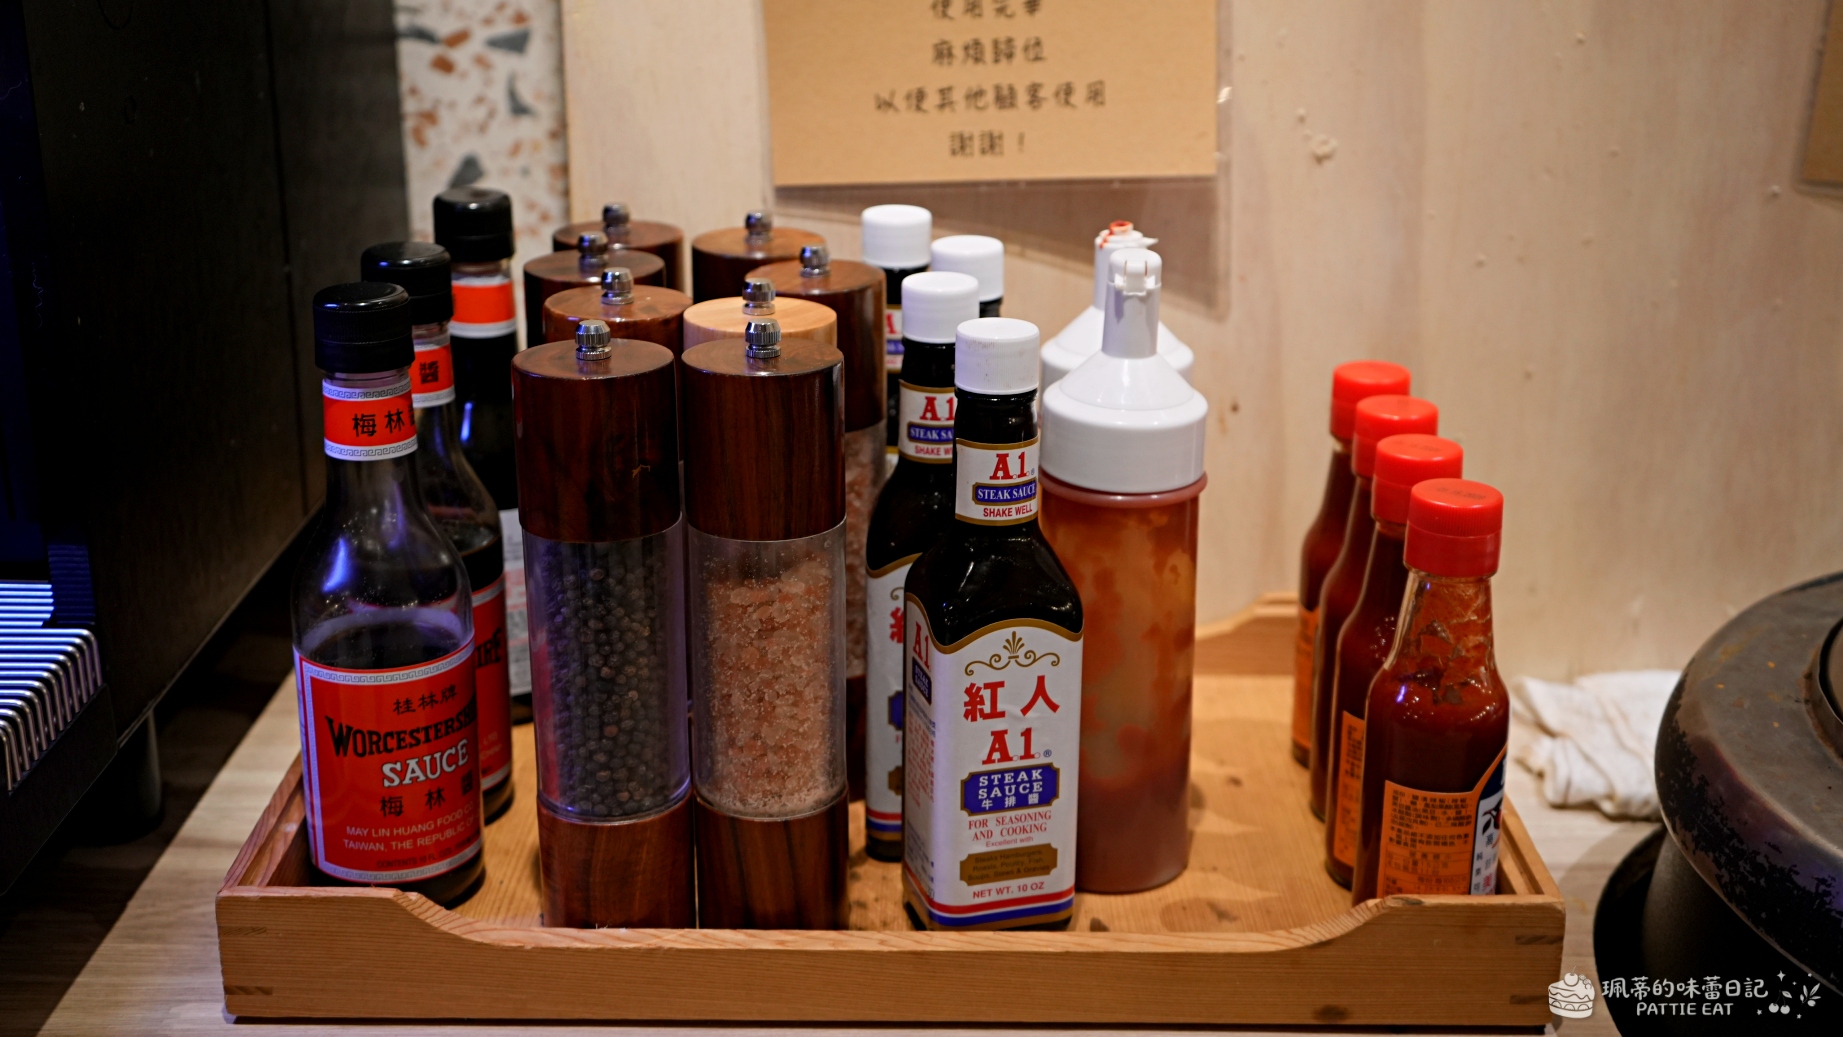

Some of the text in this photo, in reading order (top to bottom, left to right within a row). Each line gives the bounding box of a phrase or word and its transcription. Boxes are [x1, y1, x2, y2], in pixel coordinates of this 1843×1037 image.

[932, 36, 1046, 66] 麻煩歸位
[874, 80, 1108, 114] 以便其他顧客使用
[910, 426, 940, 440] STEAK
[915, 444, 942, 456] SHAKE
[977, 482, 1036, 500] STEAK SAUCE
[983, 502, 1033, 518] SHAKE WELL
[392, 684, 458, 716] 桂林牌
[963, 674, 1060, 722] 紅人
[325, 690, 477, 758] WORCESTERSH
[381, 737, 470, 789] SAUCE
[979, 768, 1043, 787] STEAK
[978, 781, 1043, 800] SAUCE
[346, 825, 370, 837] MAY
[371, 827, 391, 838] LIN
[393, 820, 435, 837] HUANG
[437, 808, 464, 827] FOOD
[968, 810, 1052, 830] FOR SEASONING
[390, 839, 414, 850] THE
[417, 820, 466, 847] REPUBLIC
[972, 822, 1048, 841] AND COOKING
[985, 838, 1018, 848] Excellent
[972, 881, 1045, 900] NET WT. 10 OZ
